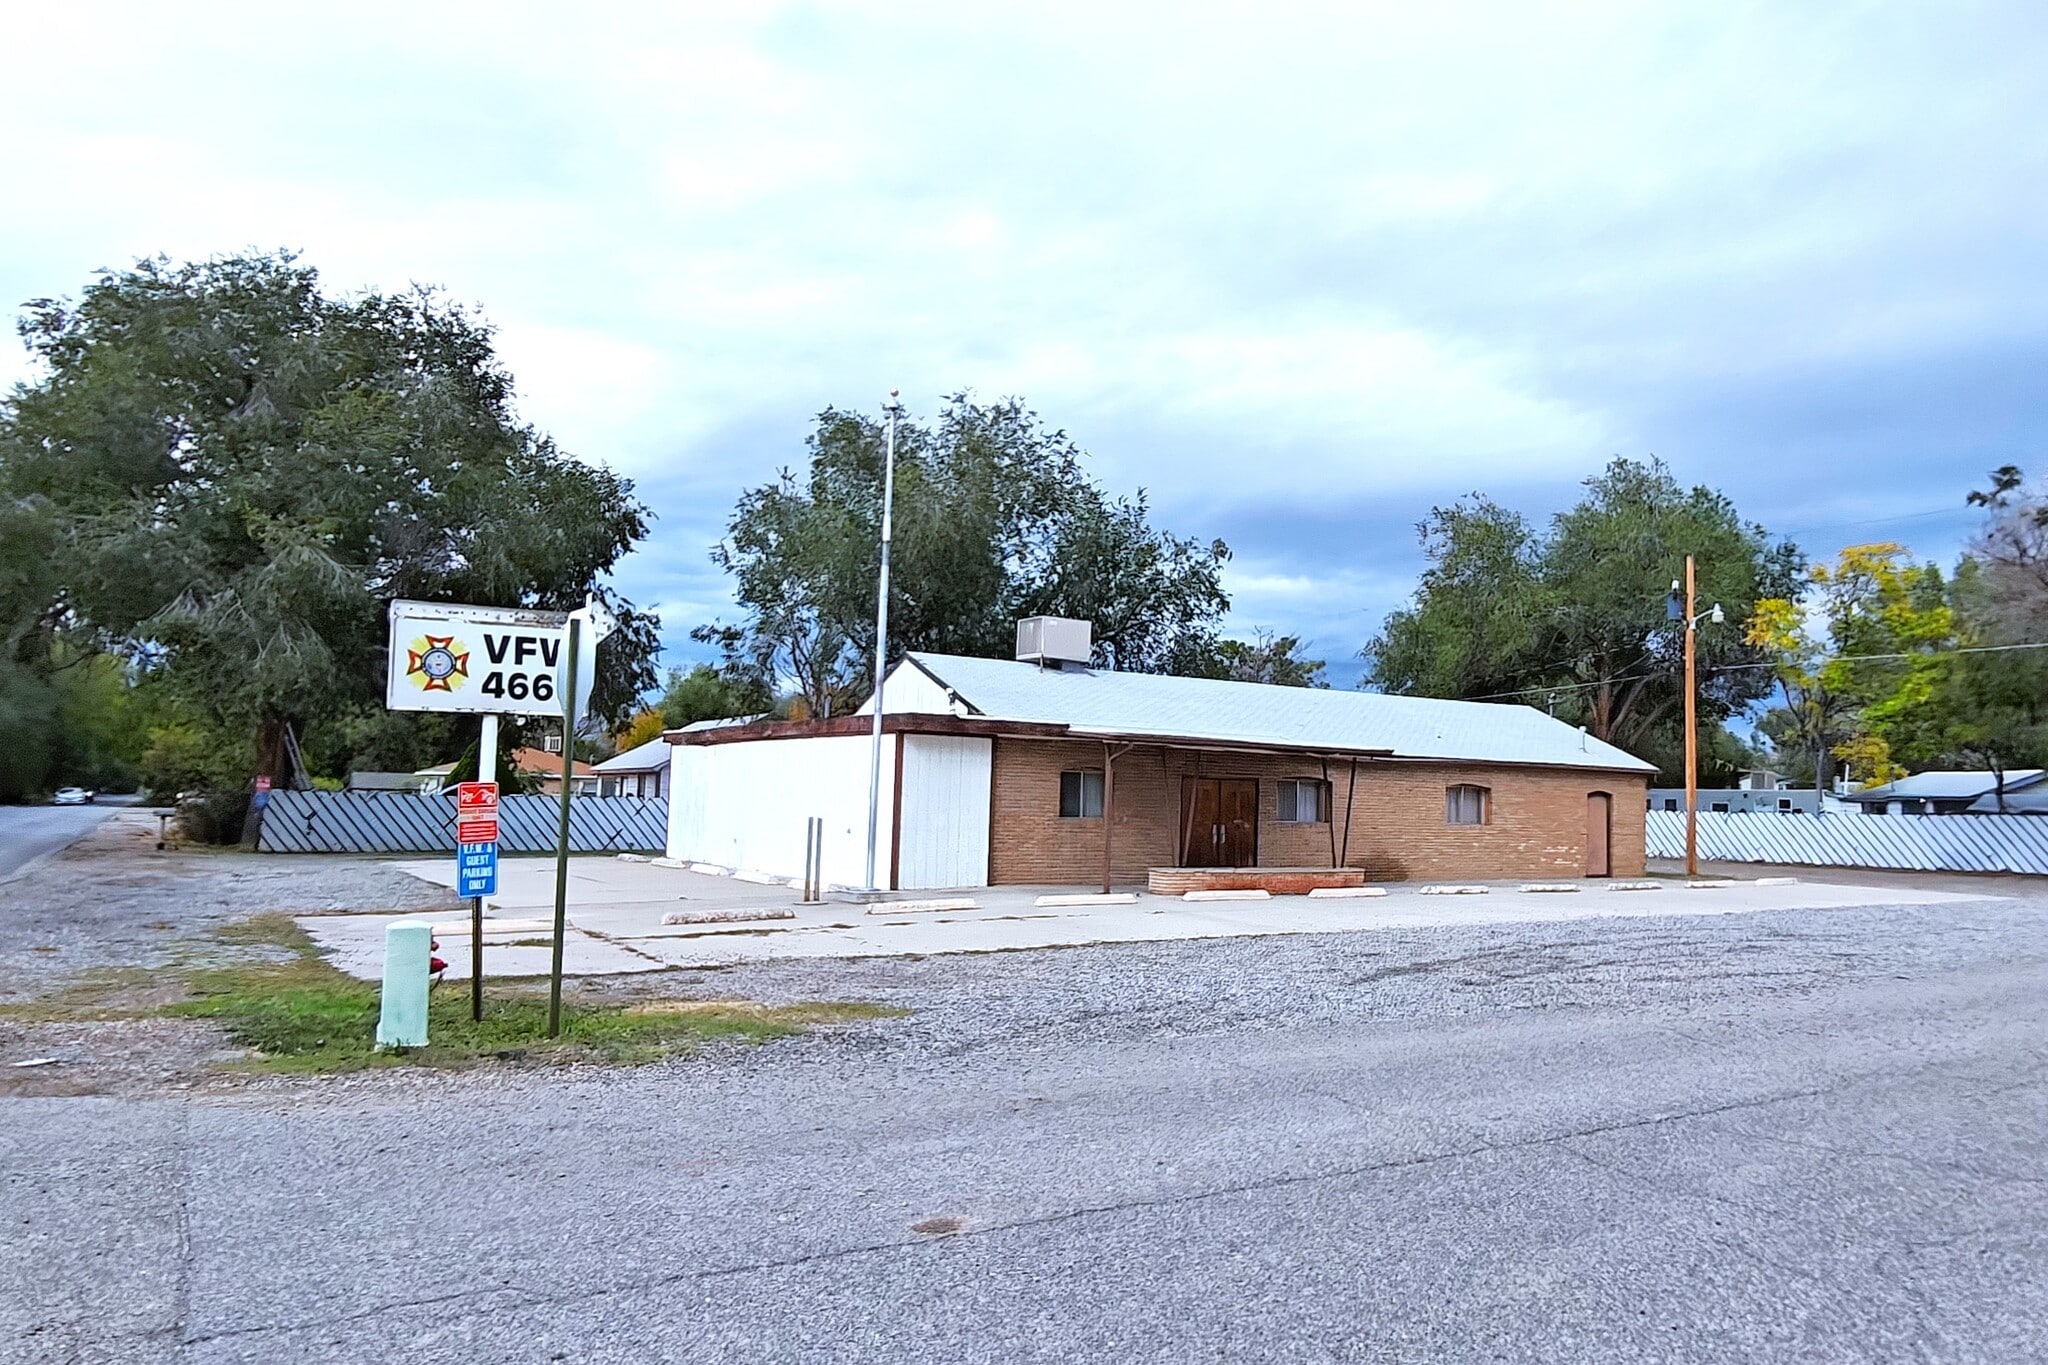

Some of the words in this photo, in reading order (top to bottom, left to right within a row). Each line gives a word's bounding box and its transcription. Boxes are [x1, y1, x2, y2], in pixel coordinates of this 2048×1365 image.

[481, 671, 554, 702] 466
[466, 855, 489, 866] GUEST
[462, 866, 493, 879] PARKING
[469, 879, 486, 890] ONLY
